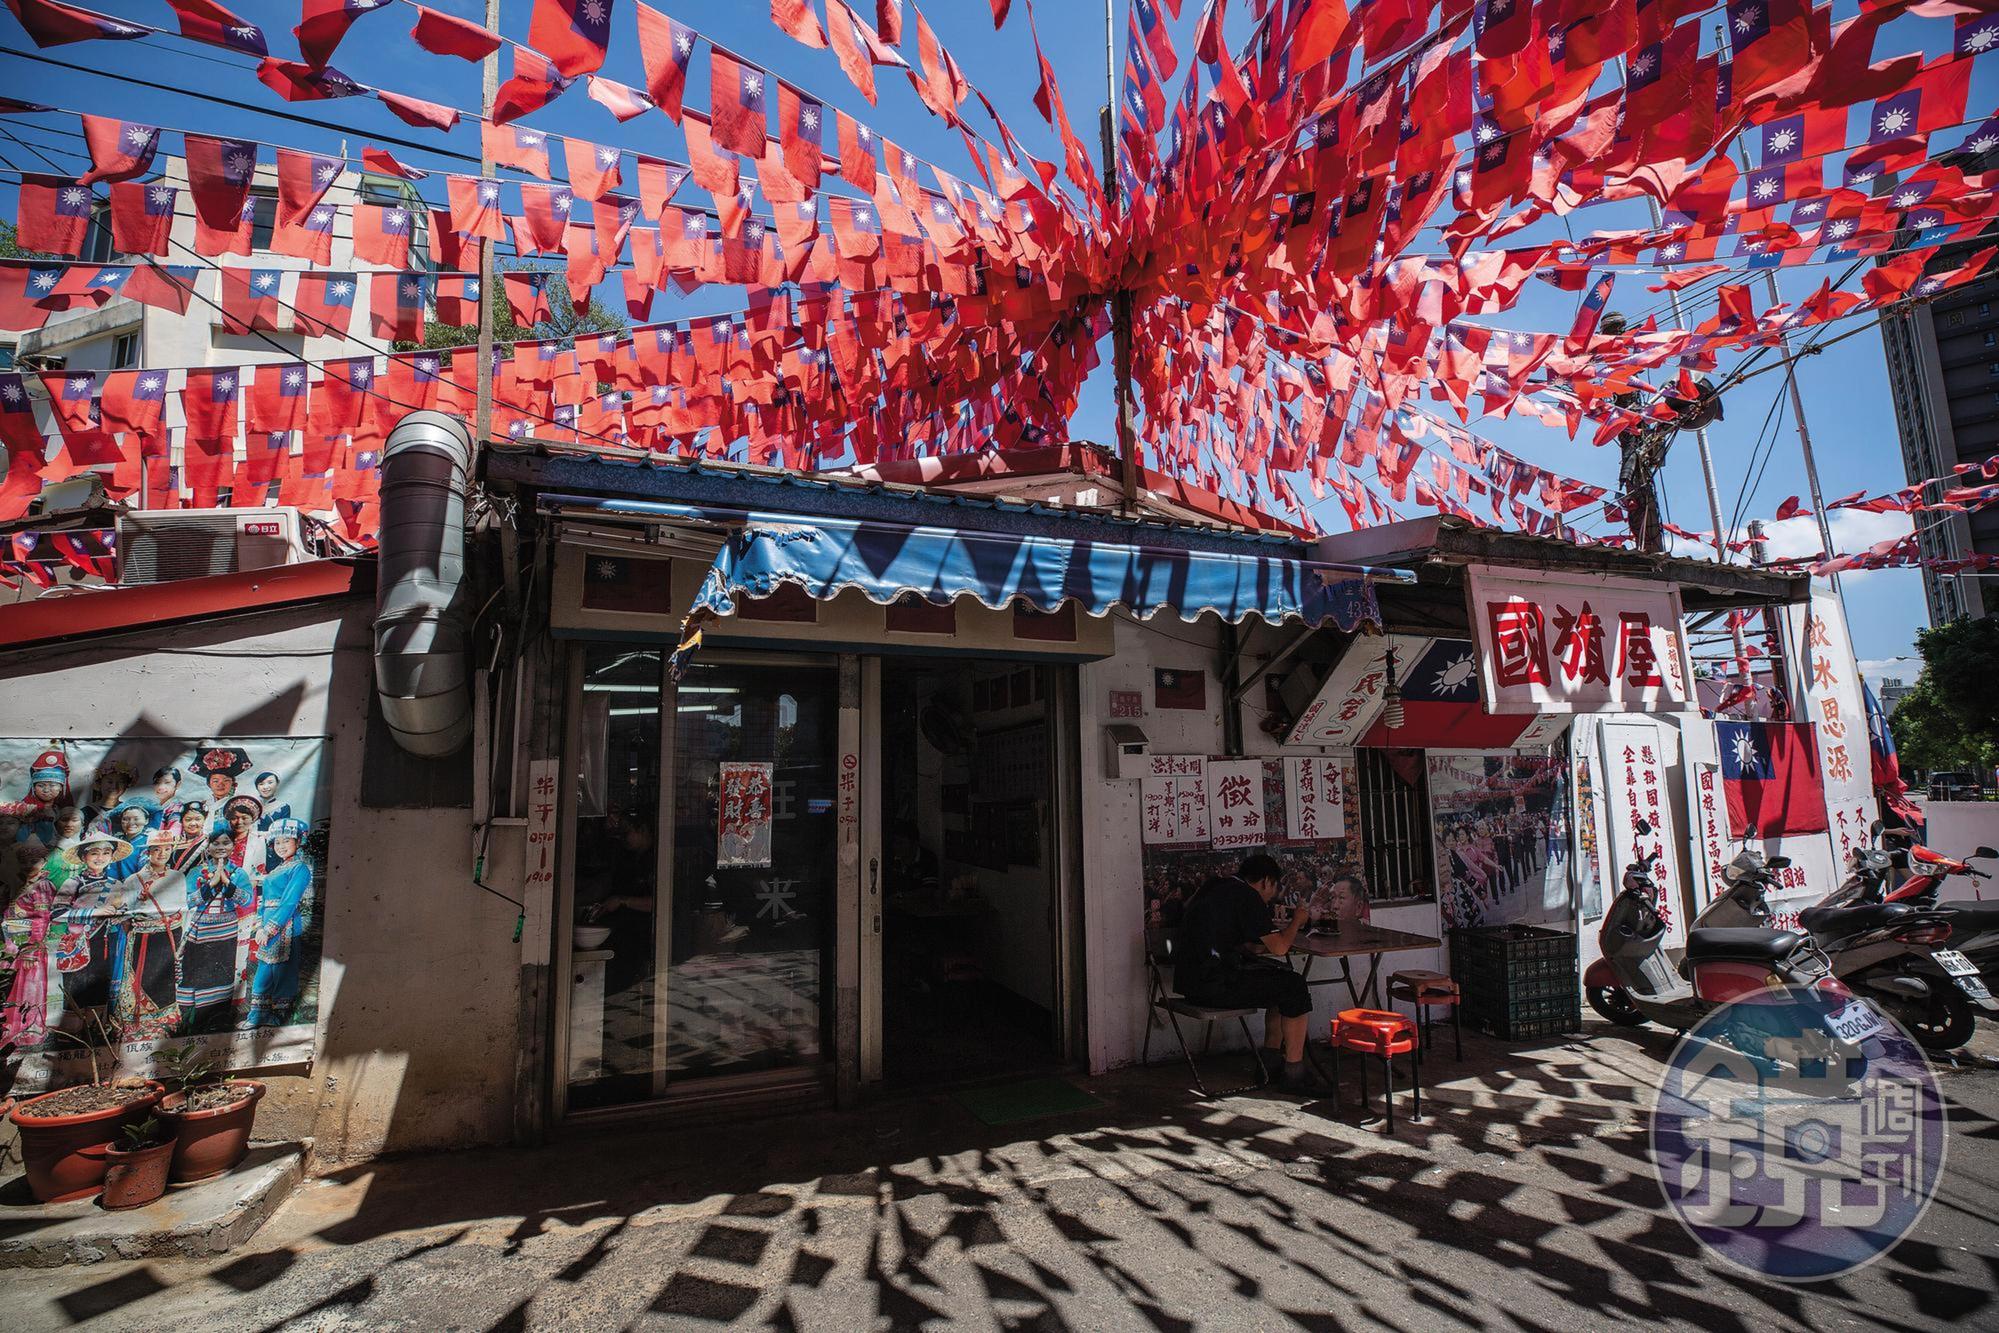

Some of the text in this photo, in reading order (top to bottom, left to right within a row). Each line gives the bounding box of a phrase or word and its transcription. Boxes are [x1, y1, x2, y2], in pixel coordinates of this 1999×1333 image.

[261, 525, 278, 533] 日立
[1487, 600, 1664, 689] 國旗屋
[1807, 614, 1853, 783] 飲水思源
[1150, 756, 1202, 774] 營業時間
[1323, 762, 1341, 806] 每逢
[725, 778, 745, 826] 發財
[746, 774, 768, 819] 恭喜
[1217, 775, 1254, 810] 徵
[1300, 758, 1319, 838] 星期四公休
[1219, 811, 1260, 828] 內洽
